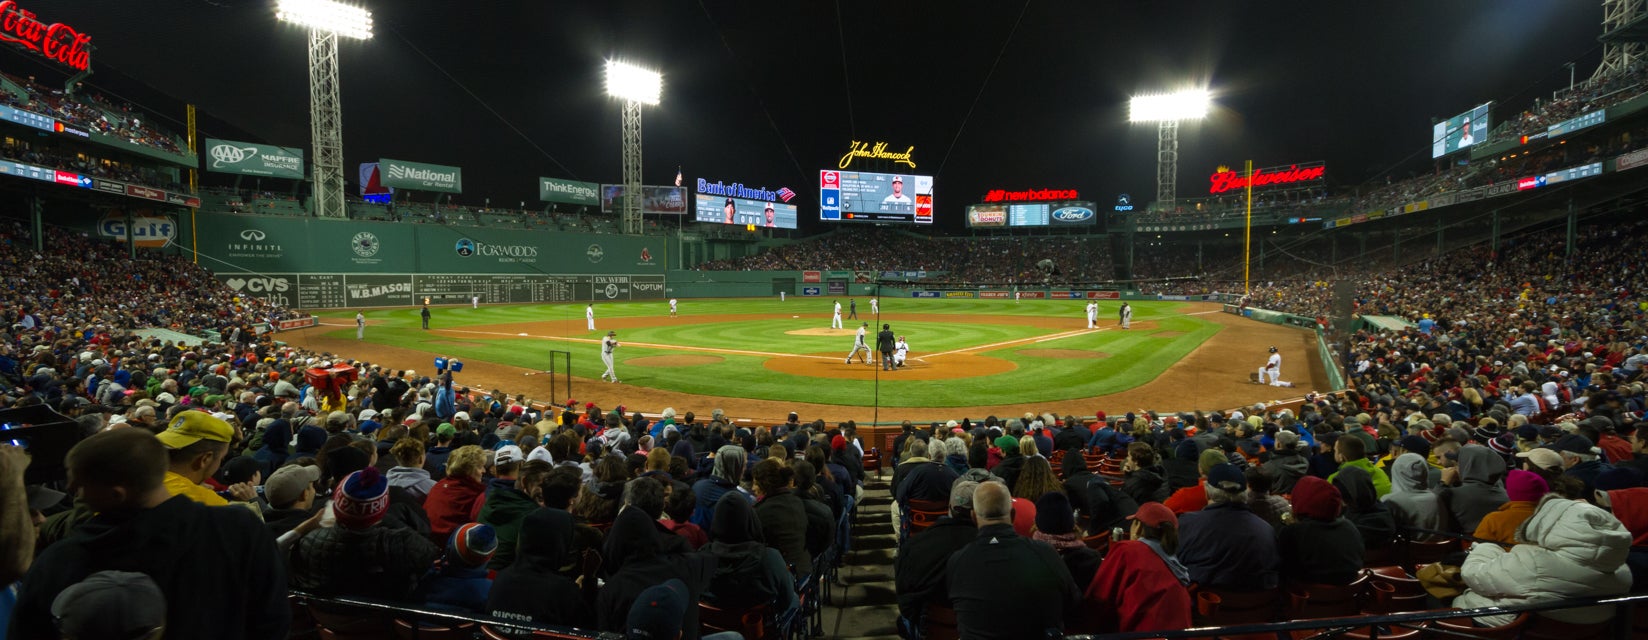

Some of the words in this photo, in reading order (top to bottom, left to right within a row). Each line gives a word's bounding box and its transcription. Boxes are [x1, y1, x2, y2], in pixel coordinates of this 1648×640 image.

[215, 147, 241, 162] AAA
[261, 154, 300, 164] MAPFRE
[838, 140, 871, 169] John
[871, 141, 917, 169] Hancock
[404, 167, 457, 184] National
[1210, 164, 1326, 194] Budweiser
[697, 178, 726, 195] Bank
[726, 184, 738, 197] of
[738, 184, 776, 202] America
[1005, 191, 1028, 201] new
[1029, 188, 1079, 201] balance
[1060, 208, 1086, 219] Ford
[103, 218, 171, 238] Gulf
[228, 243, 281, 251] INFINITI
[247, 277, 289, 292] CVS
[640, 283, 663, 291] OPTUM
